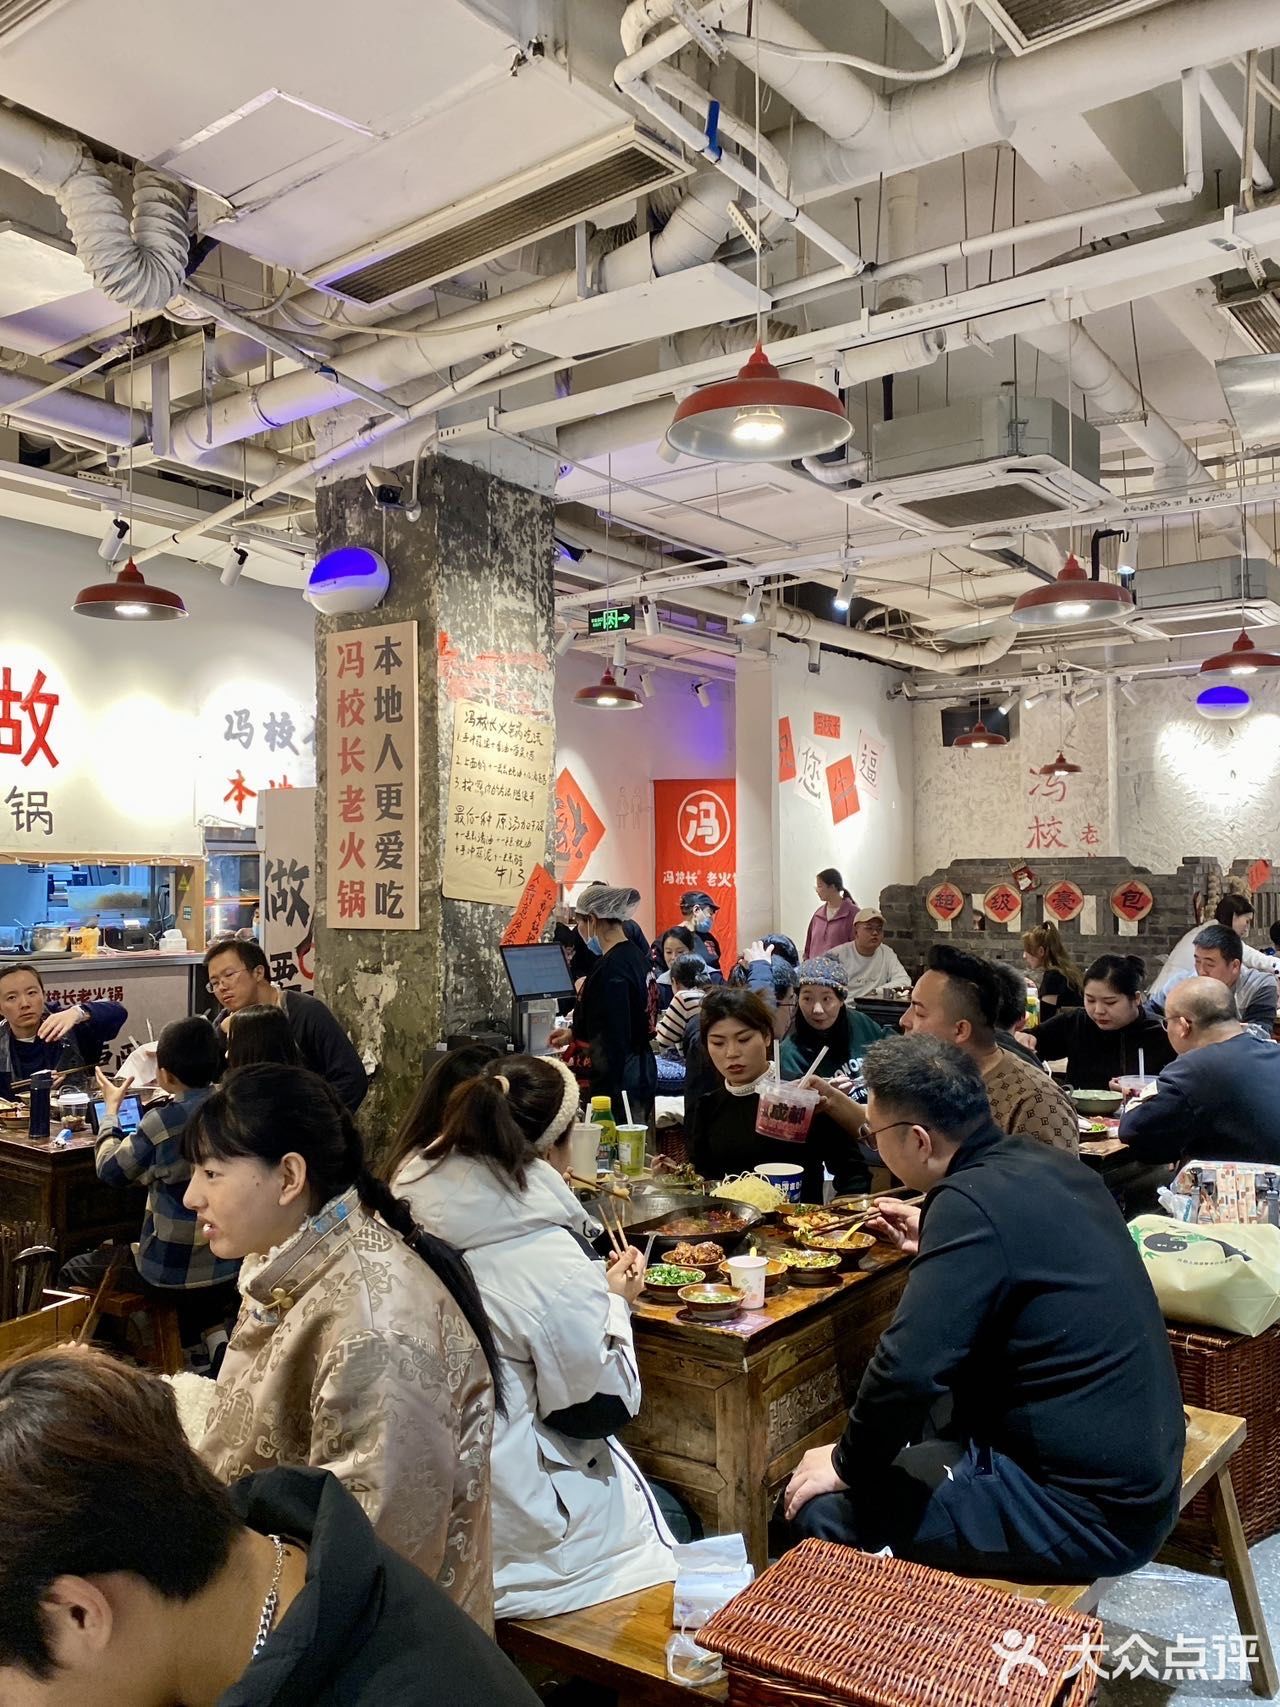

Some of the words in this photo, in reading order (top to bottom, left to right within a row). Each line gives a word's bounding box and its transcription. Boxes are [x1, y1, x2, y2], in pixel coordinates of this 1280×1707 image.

[336, 640, 366, 920] 冯校长老火锅
[373, 635, 404, 920] 本地人更爱吃
[4, 785, 53, 836] 锅
[685, 801, 720, 846] 冯
[662, 870, 698, 886] 冯校长
[991, 892, 1014, 912] 级
[1120, 888, 1145, 912] 包
